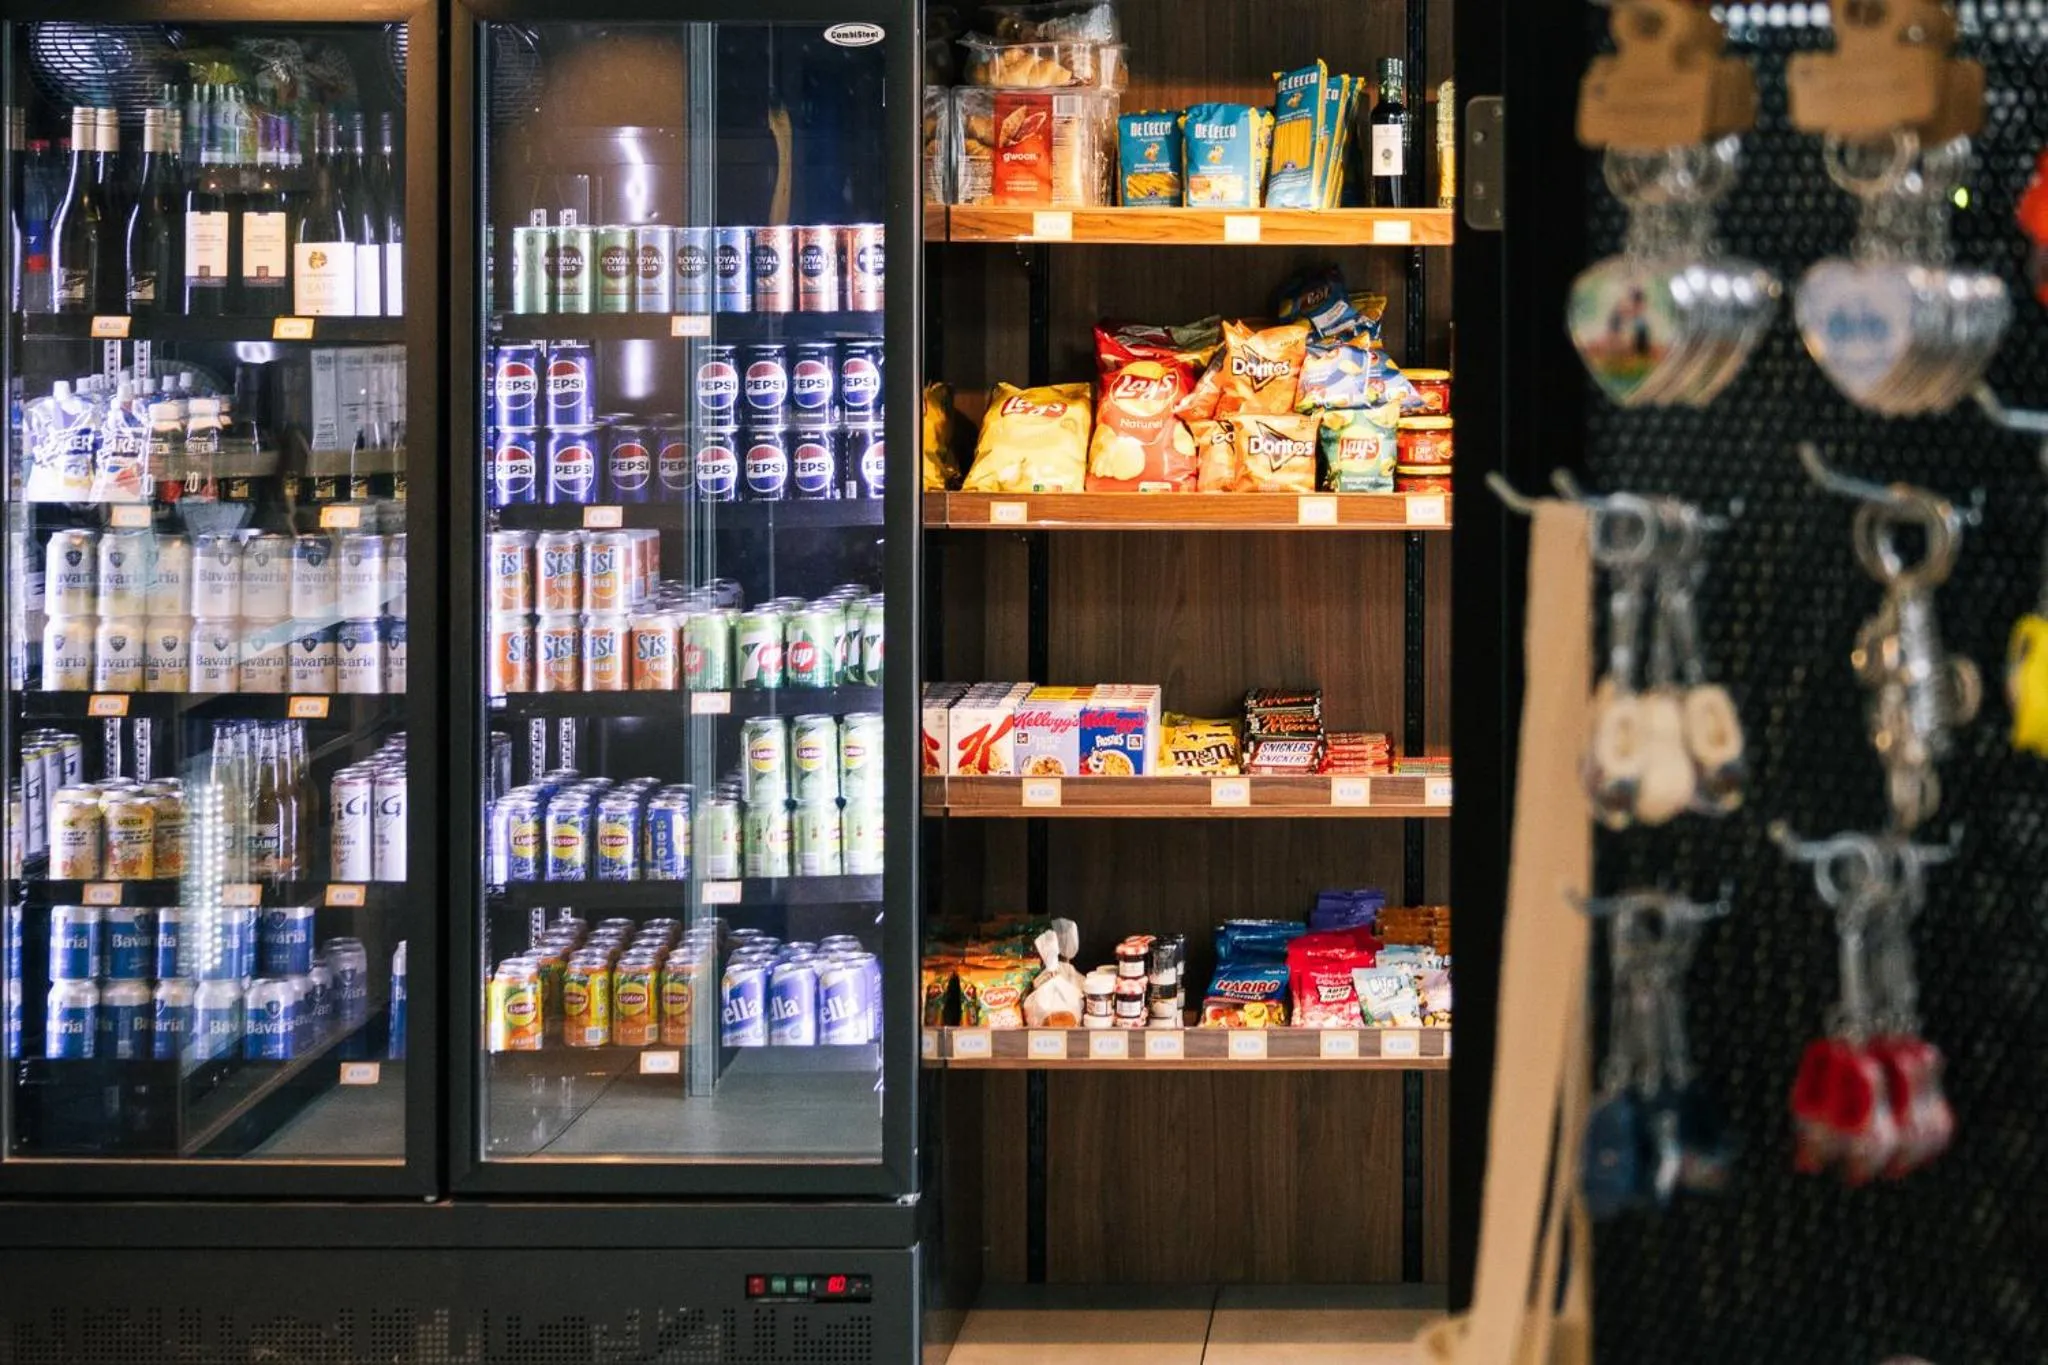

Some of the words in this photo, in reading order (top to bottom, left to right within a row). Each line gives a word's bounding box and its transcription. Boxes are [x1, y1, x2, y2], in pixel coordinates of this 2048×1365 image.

[830, 31, 879, 39] CombiSteel
[1232, 356, 1291, 378] Doritos
[747, 380, 785, 390] PEPSI
[1249, 436, 1313, 456] Doritos
[611, 460, 649, 472] PEPSI
[792, 650, 815, 664] up
[1014, 710, 1081, 733] Kellogg's
[1261, 743, 1313, 753] SNICKERS
[1258, 755, 1308, 764] SNICKERS
[1215, 980, 1281, 993] HARIBO
